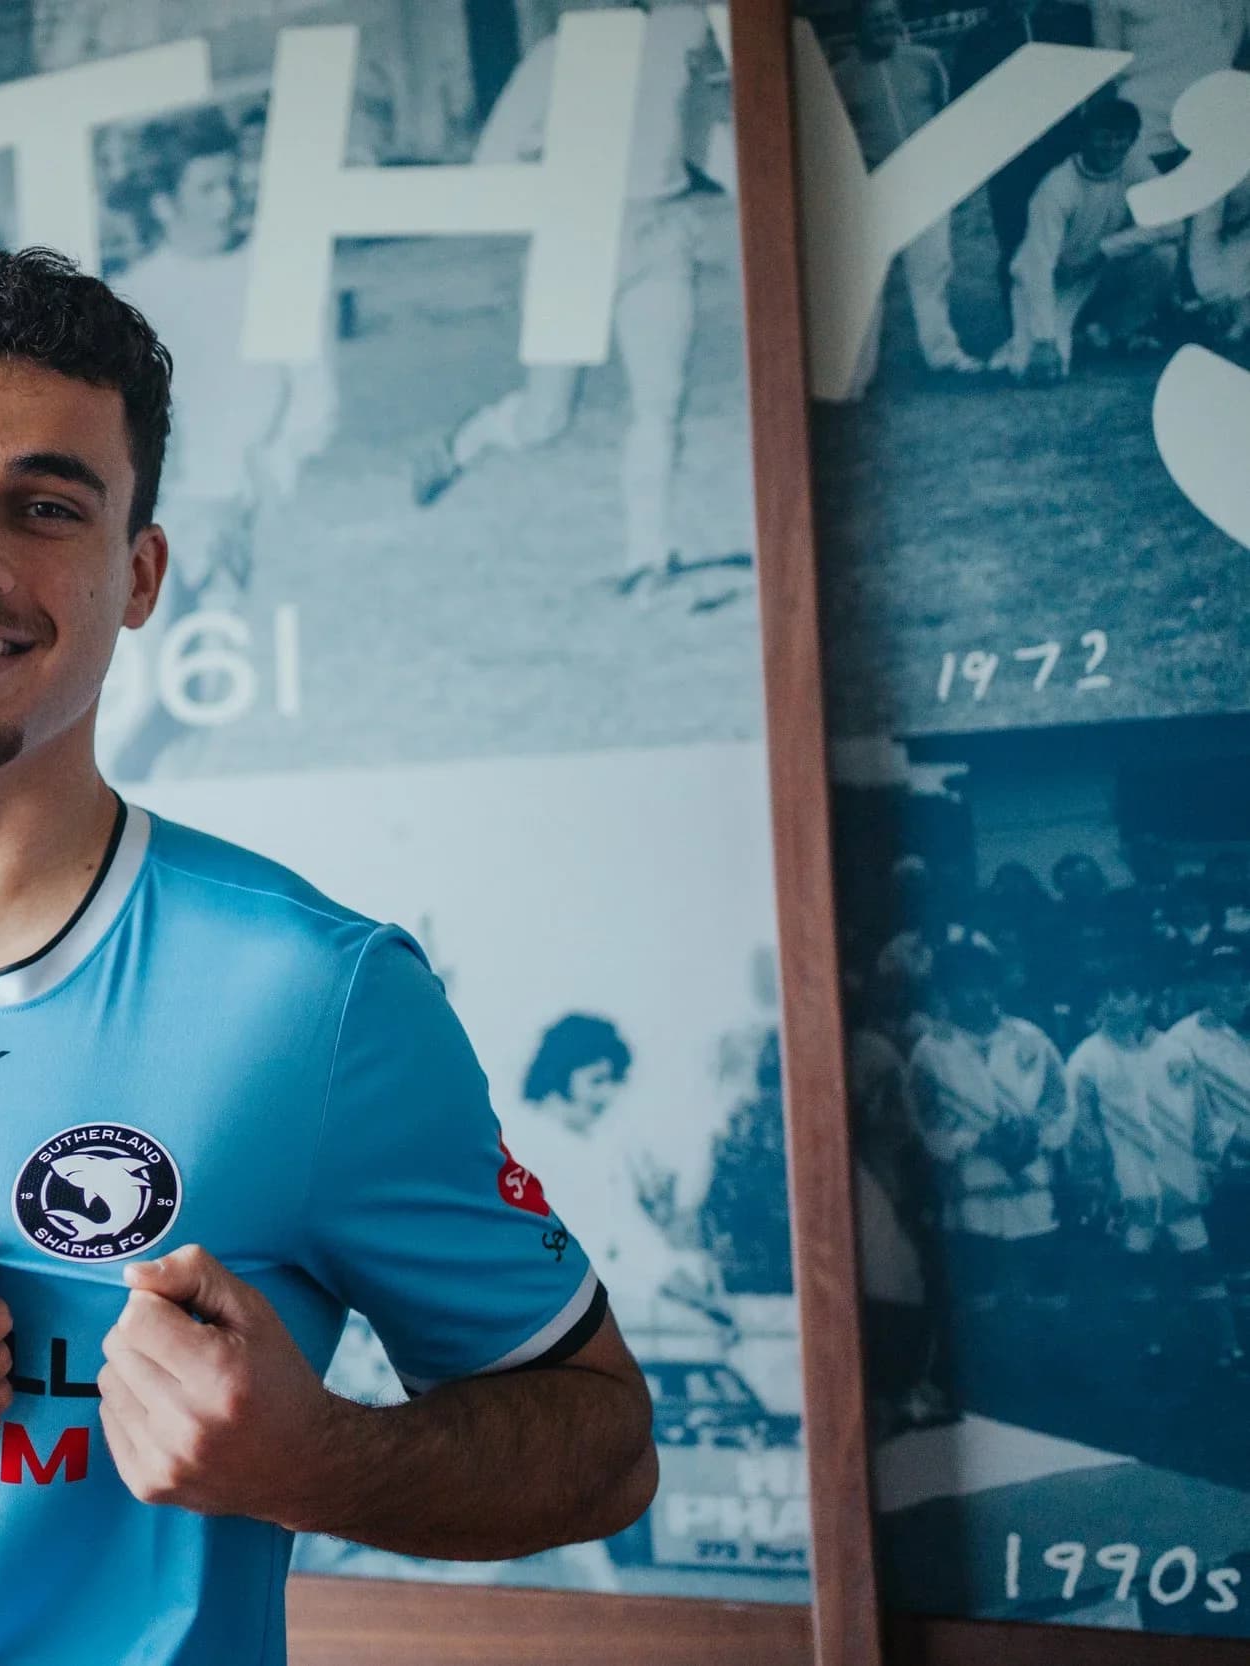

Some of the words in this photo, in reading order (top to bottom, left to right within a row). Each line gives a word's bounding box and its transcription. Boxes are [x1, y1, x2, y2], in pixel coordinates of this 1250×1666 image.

[937, 629, 1112, 703] 1972
[38, 1129, 162, 1165] SUTHERLAND
[20, 1192, 35, 1201] 19
[157, 1198, 175, 1208] 30
[34, 1227, 114, 1256] SHARKS
[118, 1232, 146, 1251] FC
[1005, 1532, 1242, 1613] 1990s
